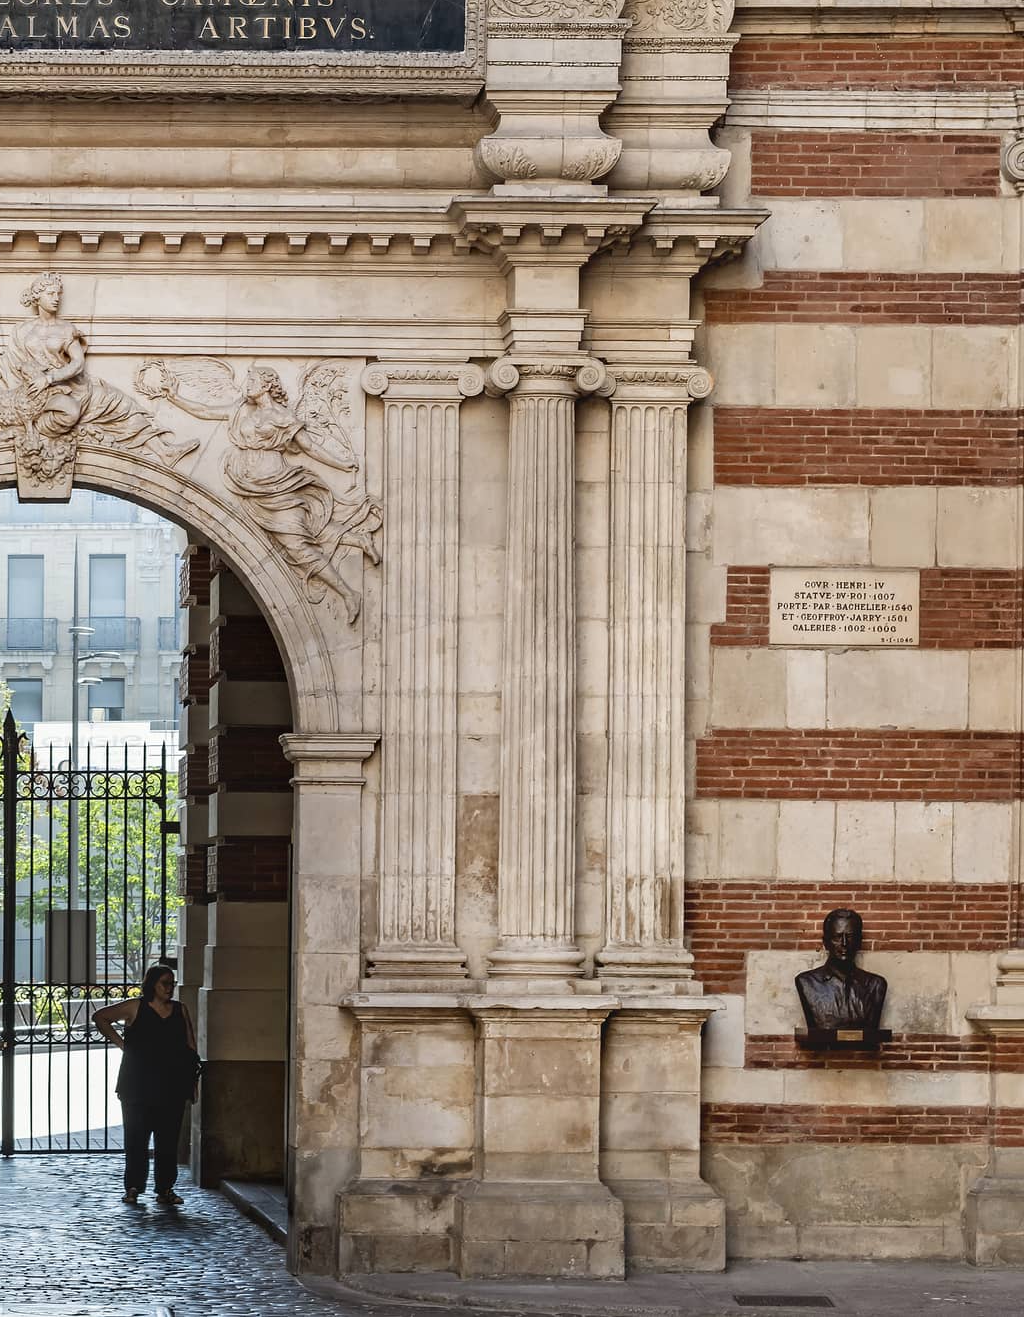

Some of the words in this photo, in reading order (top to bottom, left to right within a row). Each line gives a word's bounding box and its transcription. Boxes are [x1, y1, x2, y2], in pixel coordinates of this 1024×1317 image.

[804, 581, 829, 589] COVR
[837, 603, 887, 611] BACHELIER
[801, 613, 845, 621] GEOFFROY
[850, 614, 881, 622] JARRY
